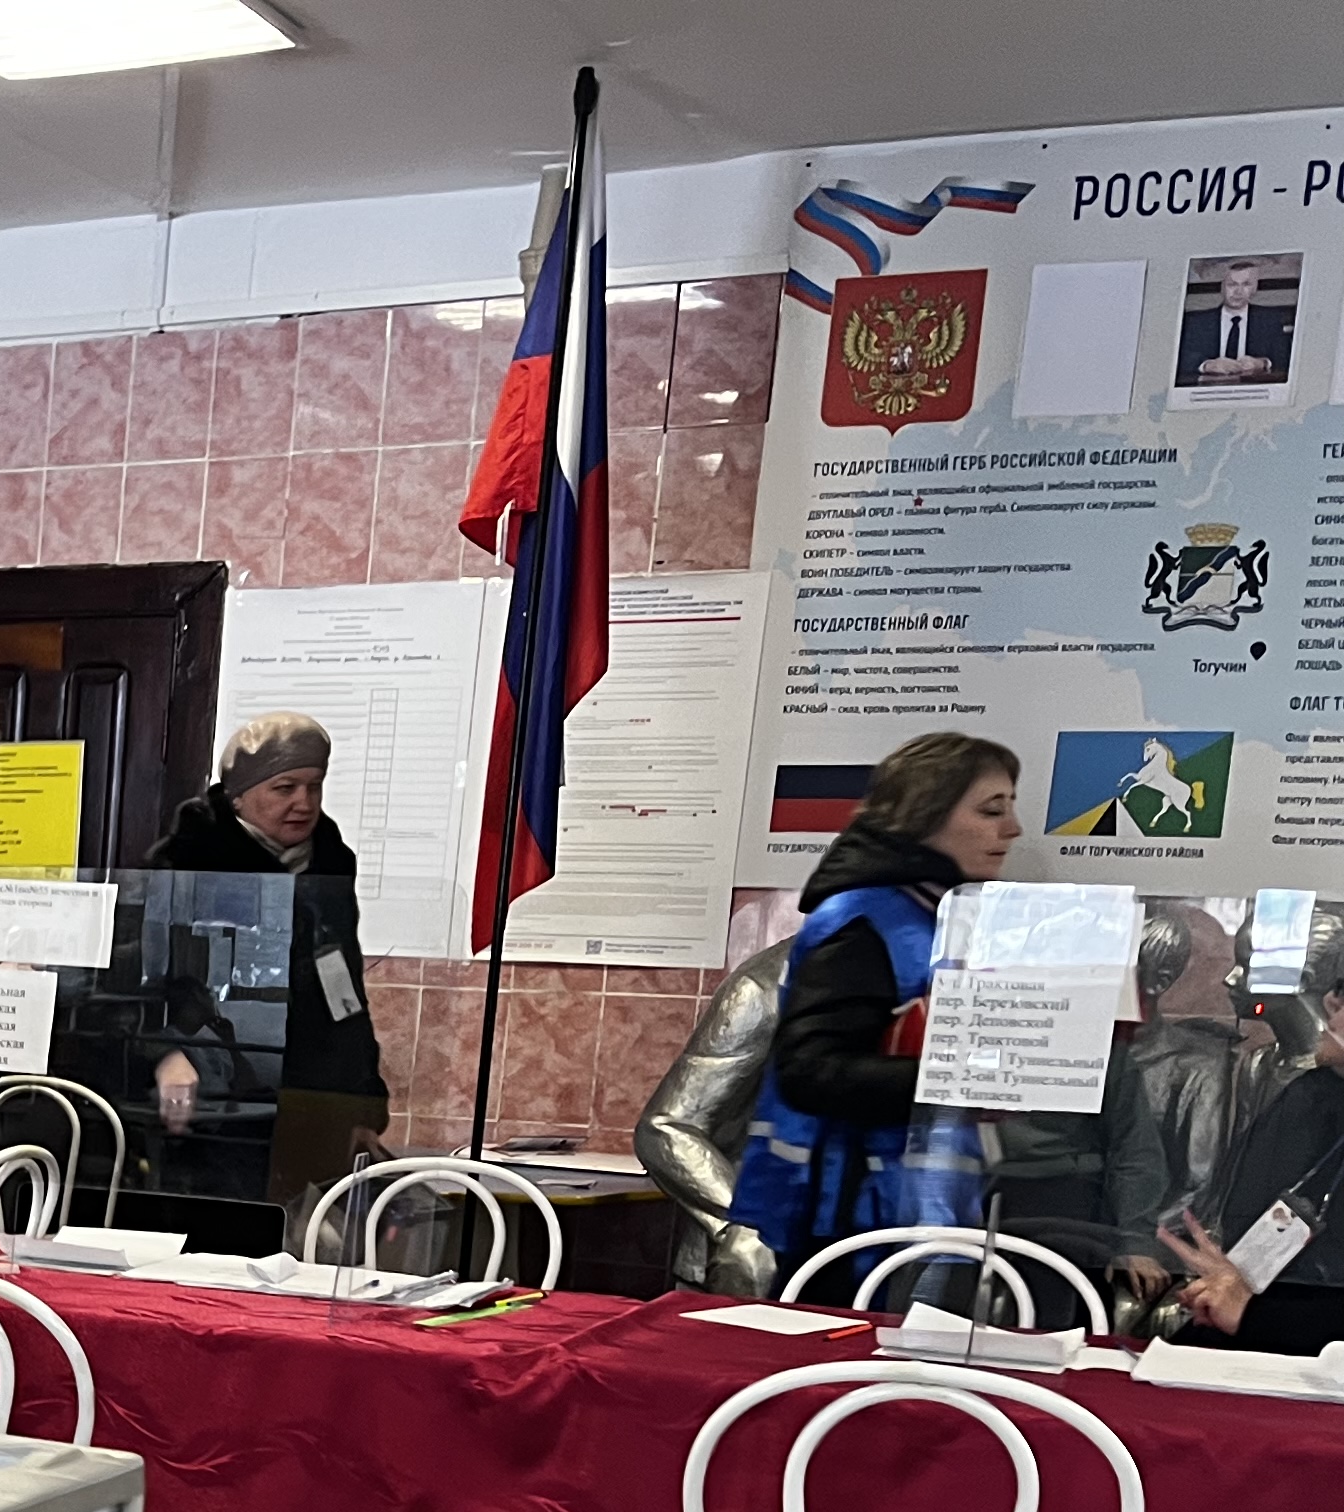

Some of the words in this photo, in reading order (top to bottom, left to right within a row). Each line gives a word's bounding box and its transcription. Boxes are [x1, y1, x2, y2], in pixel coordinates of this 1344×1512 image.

[1073, 164, 1258, 221] РОССИЯ
[814, 454, 949, 478] ГОСУДАРСТВЕННЫЙ
[952, 455, 987, 472] ГЕРБ
[990, 448, 1086, 470] РОССИЙСКОЙ
[1089, 448, 1179, 466] ФЕДЕРАЦИИ
[805, 529, 845, 540] КОРОНА
[803, 548, 847, 560] СКИПЕТР
[830, 566, 894, 579] ПОБЕДИТЕЛЬ
[793, 613, 928, 633] ГОСУДАРСТВЕННЫЙ
[932, 614, 970, 630] ФЛАГ
[1192, 658, 1247, 676] Тогучин
[783, 702, 828, 714] КРАСНЫЙ
[1290, 696, 1330, 711] ФЛАГ
[1059, 845, 1087, 858] ФЛАГ
[1089, 846, 1164, 859] ТОГУЧИНСКОГО
[1165, 846, 1205, 860] РАЙОНА
[968, 976, 1046, 993] Трактовая
[967, 1031, 1050, 1048] Трактовой
